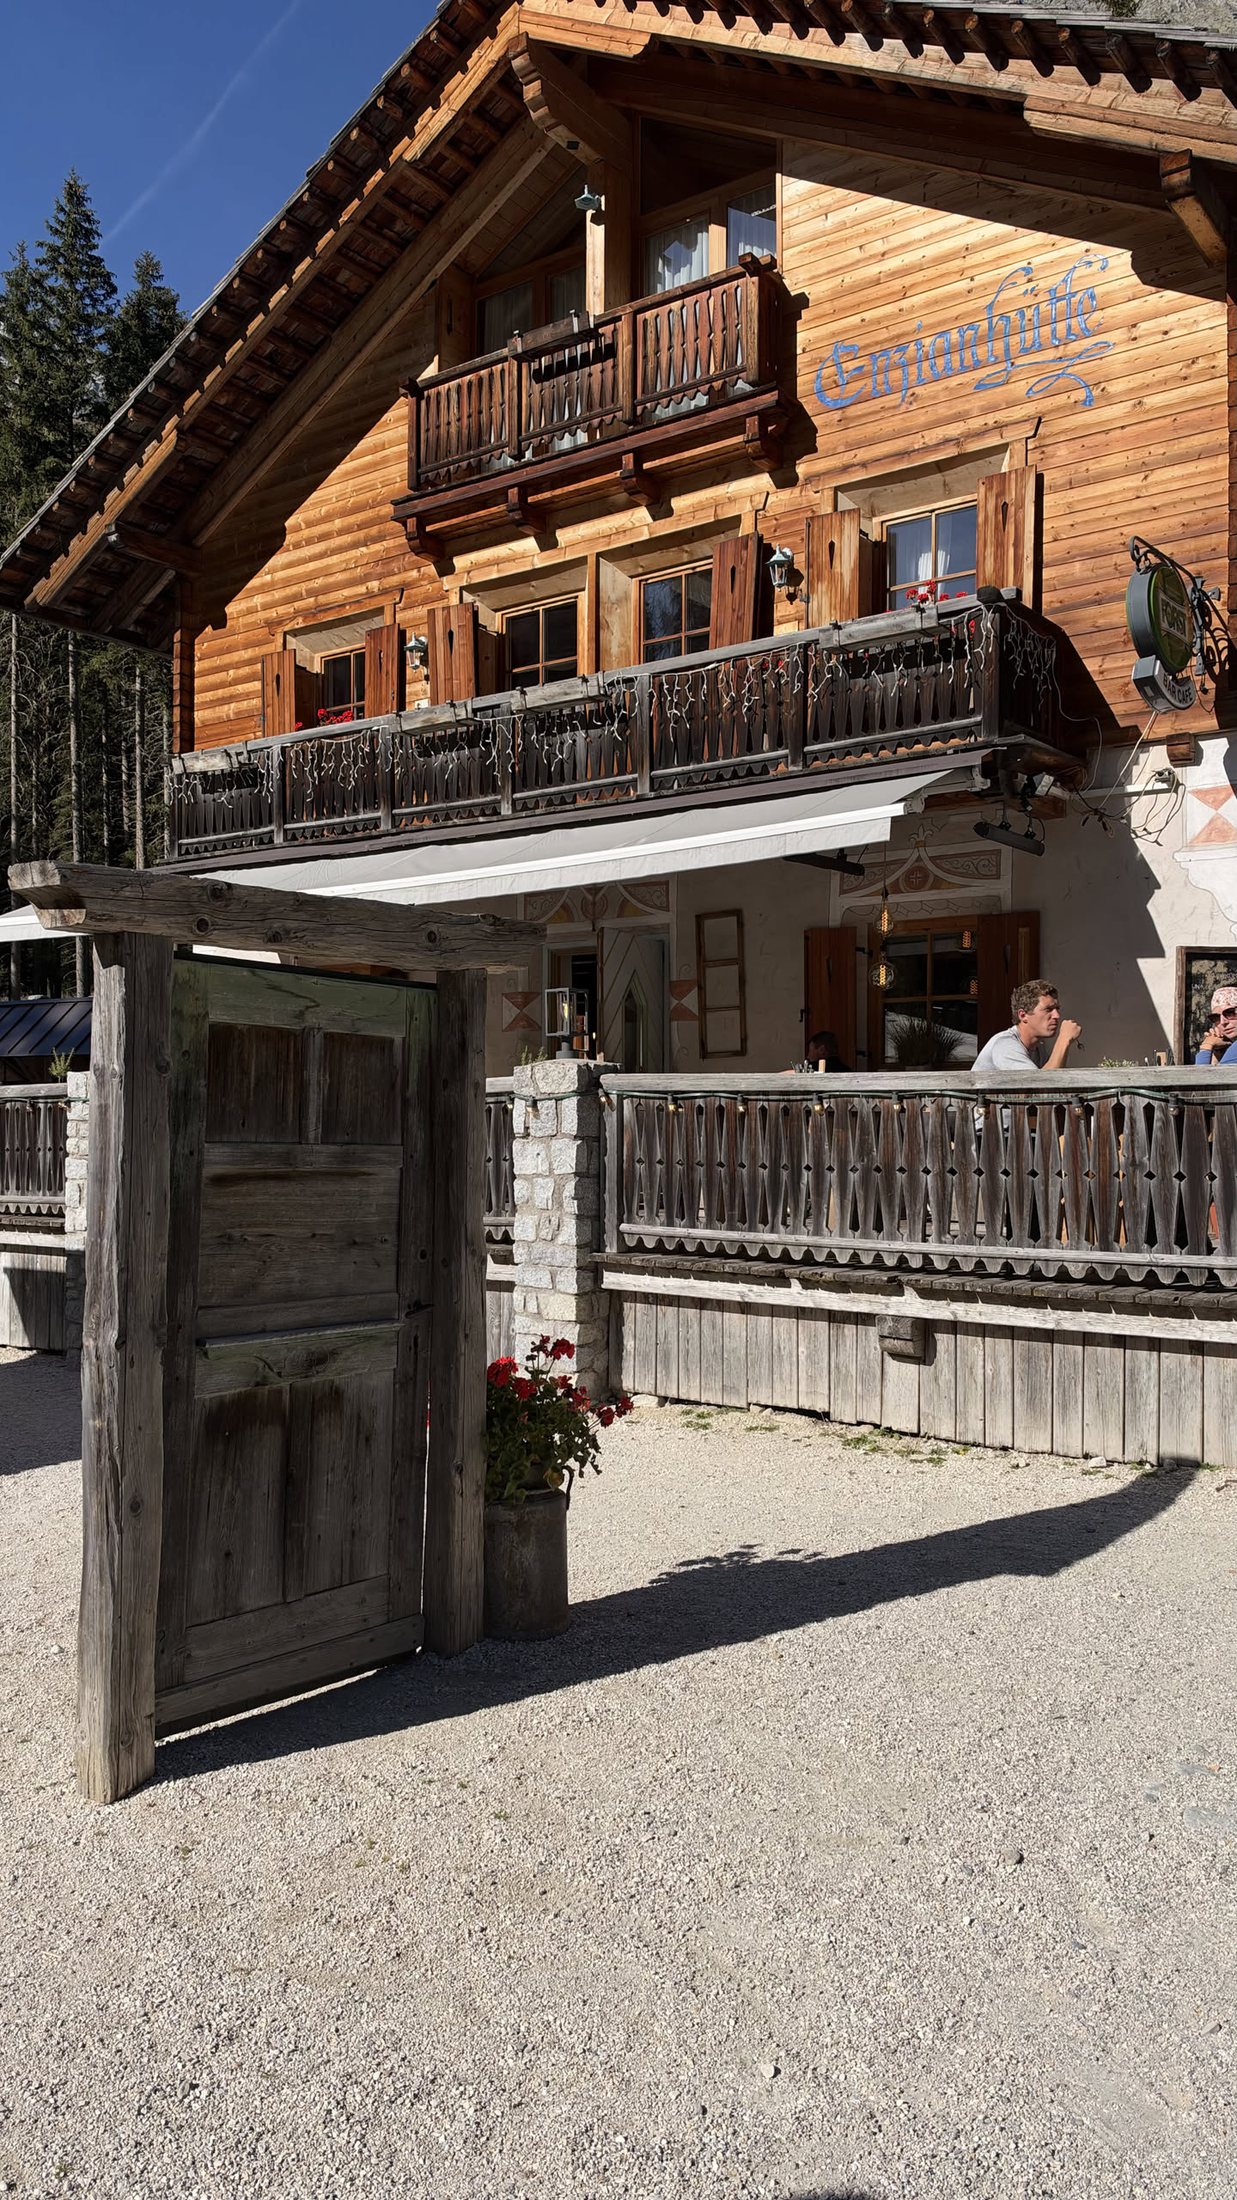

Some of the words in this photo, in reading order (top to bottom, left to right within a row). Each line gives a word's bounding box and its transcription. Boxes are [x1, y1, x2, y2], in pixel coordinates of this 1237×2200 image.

[814, 253, 1115, 408] Enzianhütte
[1161, 598, 1186, 637] FORST
[1163, 673, 1177, 700] BAR
